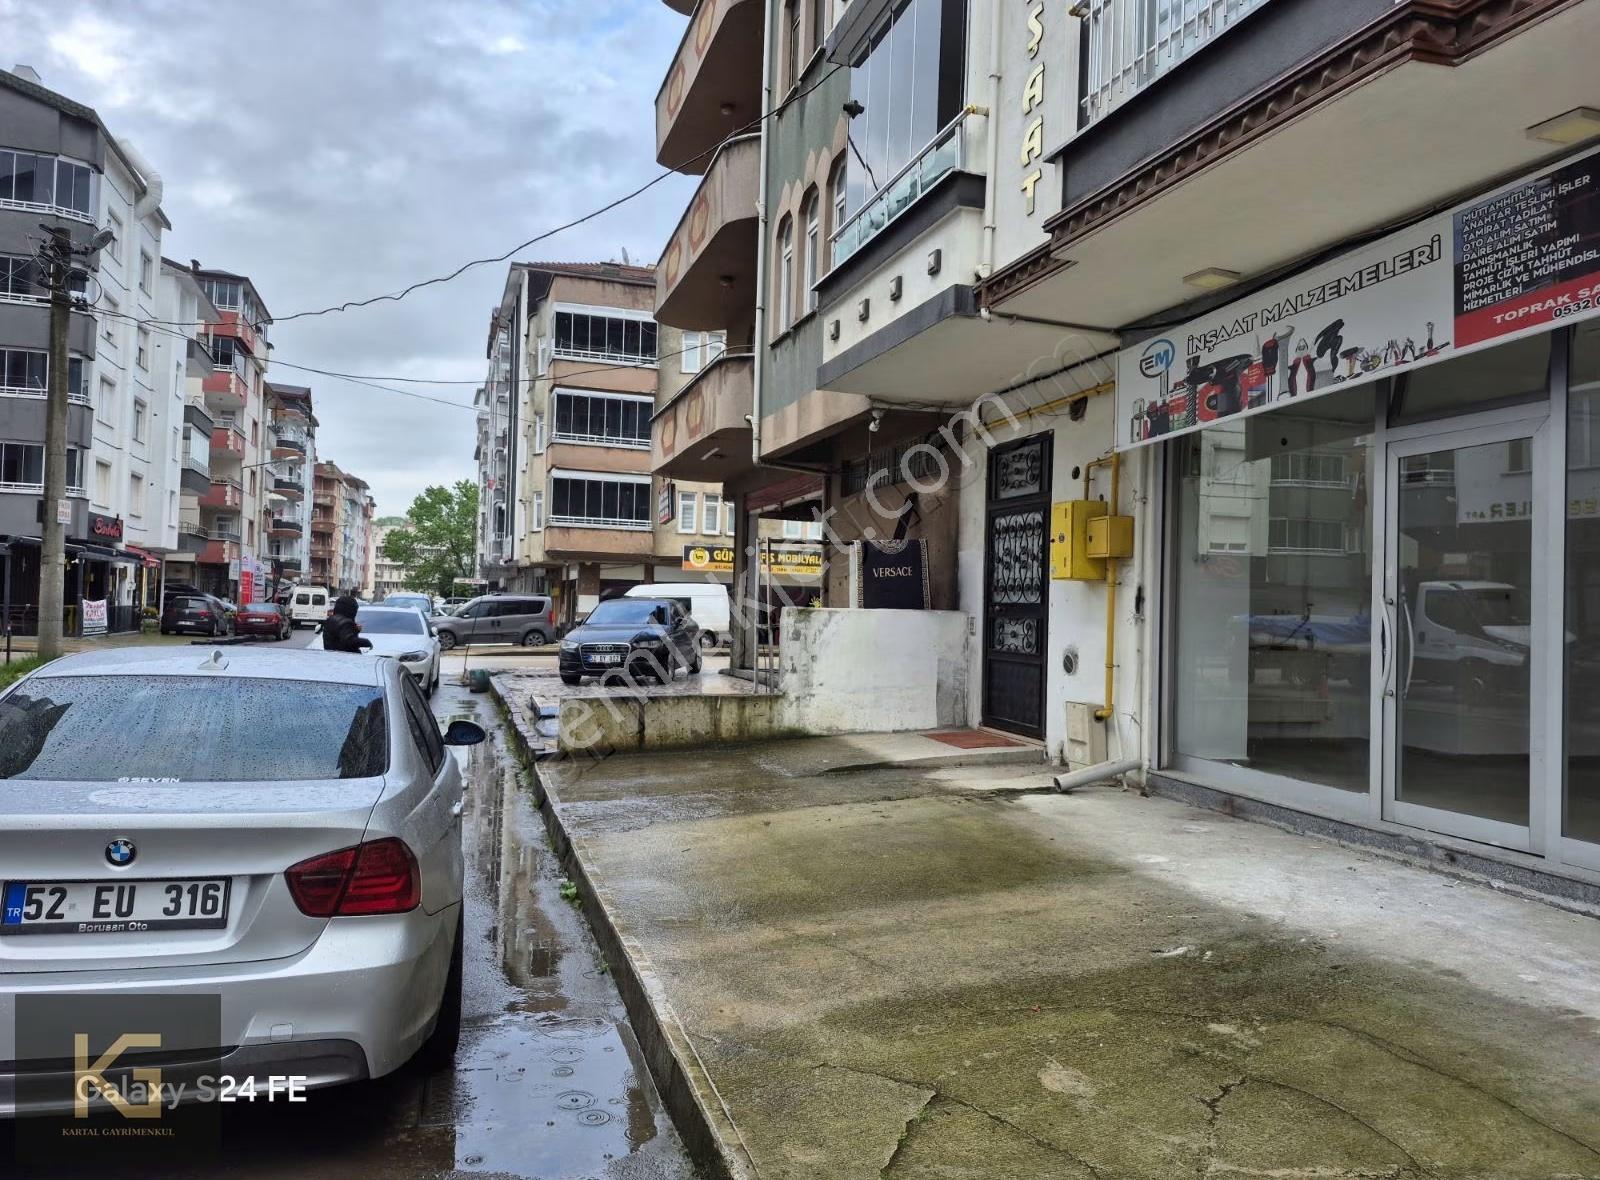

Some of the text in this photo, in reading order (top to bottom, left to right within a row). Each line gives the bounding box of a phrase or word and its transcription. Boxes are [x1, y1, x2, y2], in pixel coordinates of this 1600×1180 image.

[1020, 0, 1045, 216] ŞAAT
[1463, 174, 1591, 232] ANAHTAR TESLİMİ İŞLER
[1463, 199, 1555, 242] TAMİRAT TADİLAT
[1463, 213, 1547, 252] OTO ALIM SATIM
[1463, 219, 1557, 262] DAİRE ALIM SATIM
[1463, 240, 1533, 272] DANIŞMANLIK
[1463, 233, 1580, 281] TAHHÜT İŞLERİ YAPIMI
[1463, 246, 1573, 291] PROJE ÇİZİM TAHHÜT
[1187, 234, 1442, 355] İNŞAAT MALZEMELERİ
[1463, 278, 1512, 302] MİMARLIK
[1515, 272, 1530, 283] VE
[1463, 282, 1523, 312] HİZMETLERİ
[1493, 293, 1571, 324] TOPRAK
[1553, 298, 1591, 318] 0532
[872, 566, 913, 578] VERSACE
[7, 907, 21, 917] TR
[24, 883, 221, 920] 52 EU 316
[78, 921, 148, 933] Borusan Oto
